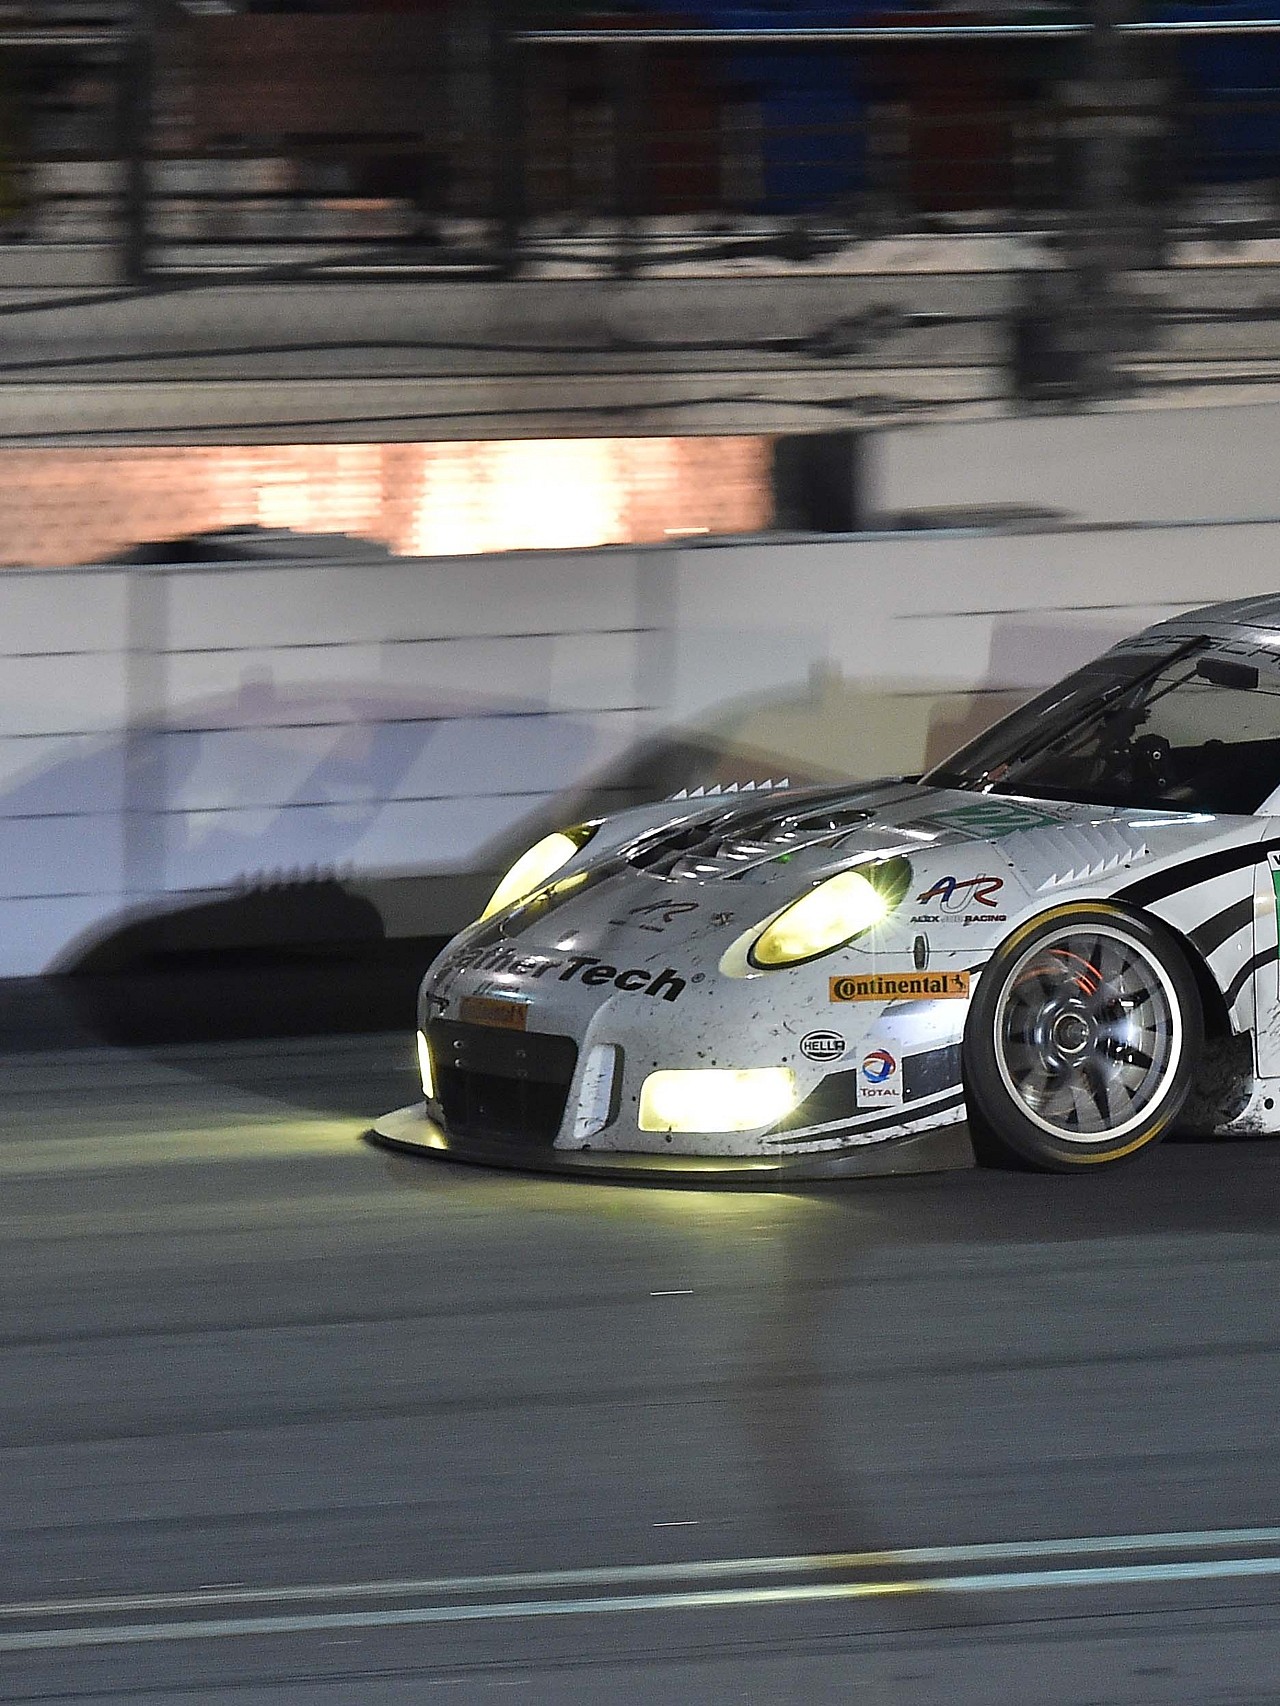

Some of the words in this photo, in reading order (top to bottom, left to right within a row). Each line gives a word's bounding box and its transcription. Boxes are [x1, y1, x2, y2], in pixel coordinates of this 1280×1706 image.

[964, 914, 1007, 923] RACING
[833, 976, 948, 1000] Continental
[803, 1040, 846, 1051] HELLA
[860, 1088, 900, 1097] TOTAL
